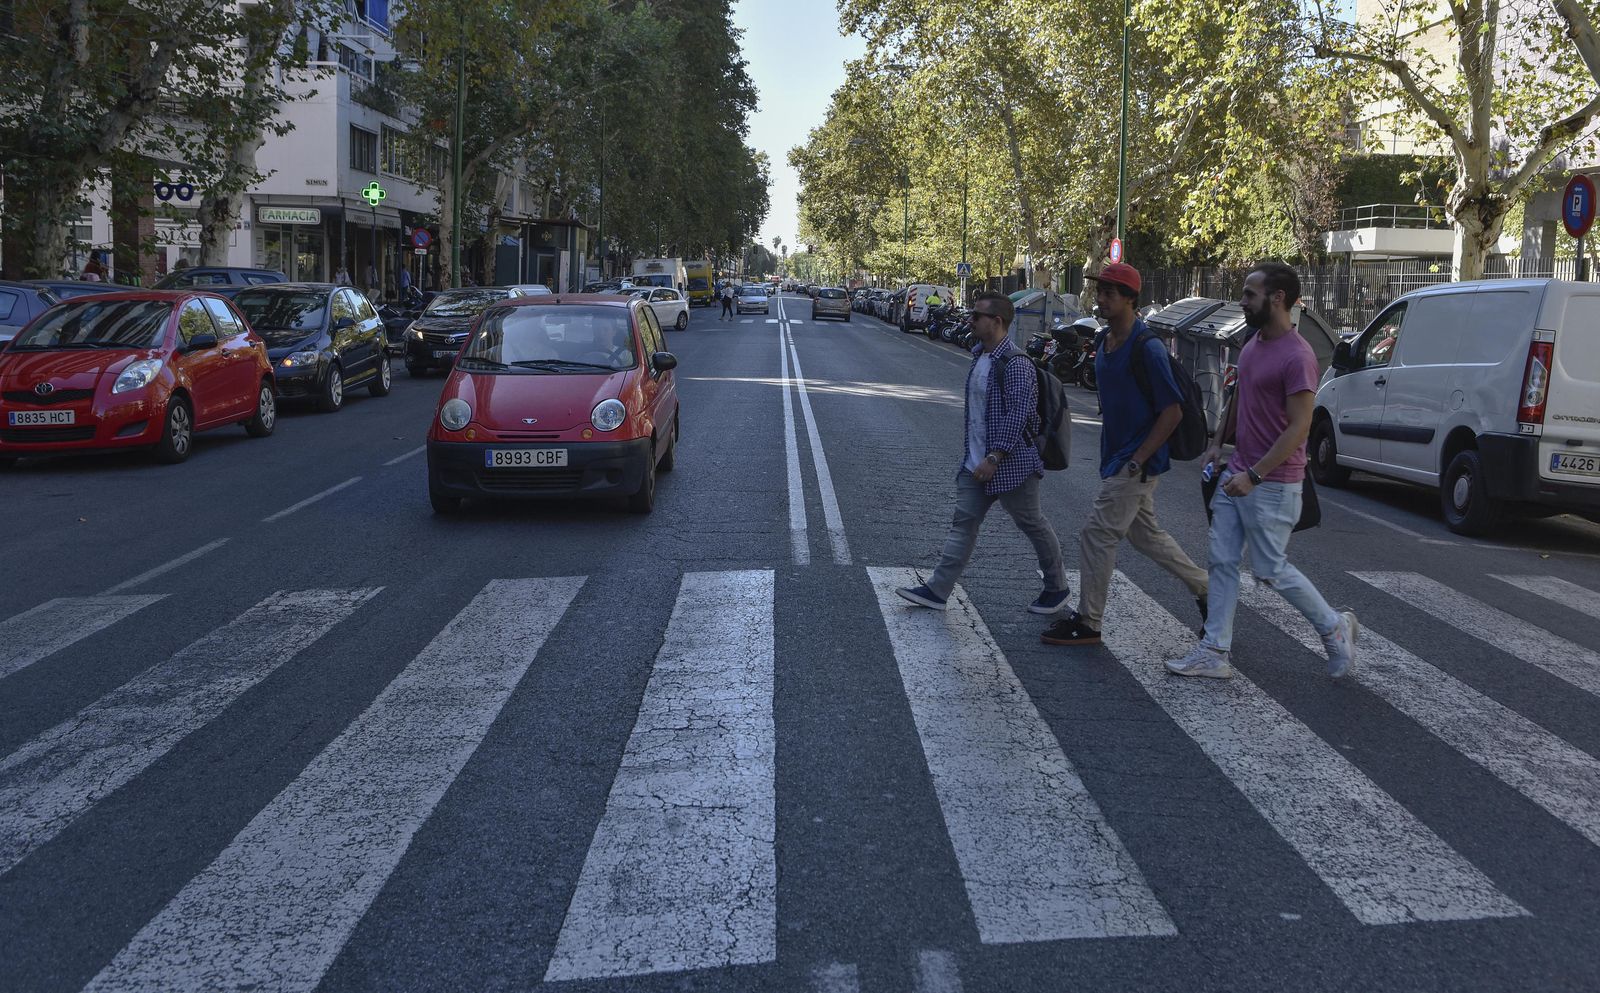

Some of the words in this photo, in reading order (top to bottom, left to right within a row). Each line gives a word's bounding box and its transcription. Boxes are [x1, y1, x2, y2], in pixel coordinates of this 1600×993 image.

[262, 210, 317, 221] FARMACIA
[17, 413, 46, 423] 8835
[50, 412, 72, 422] HCT
[495, 452, 532, 464] 8993
[536, 451, 564, 464] CBF
[1561, 457, 1595, 471] 4426
